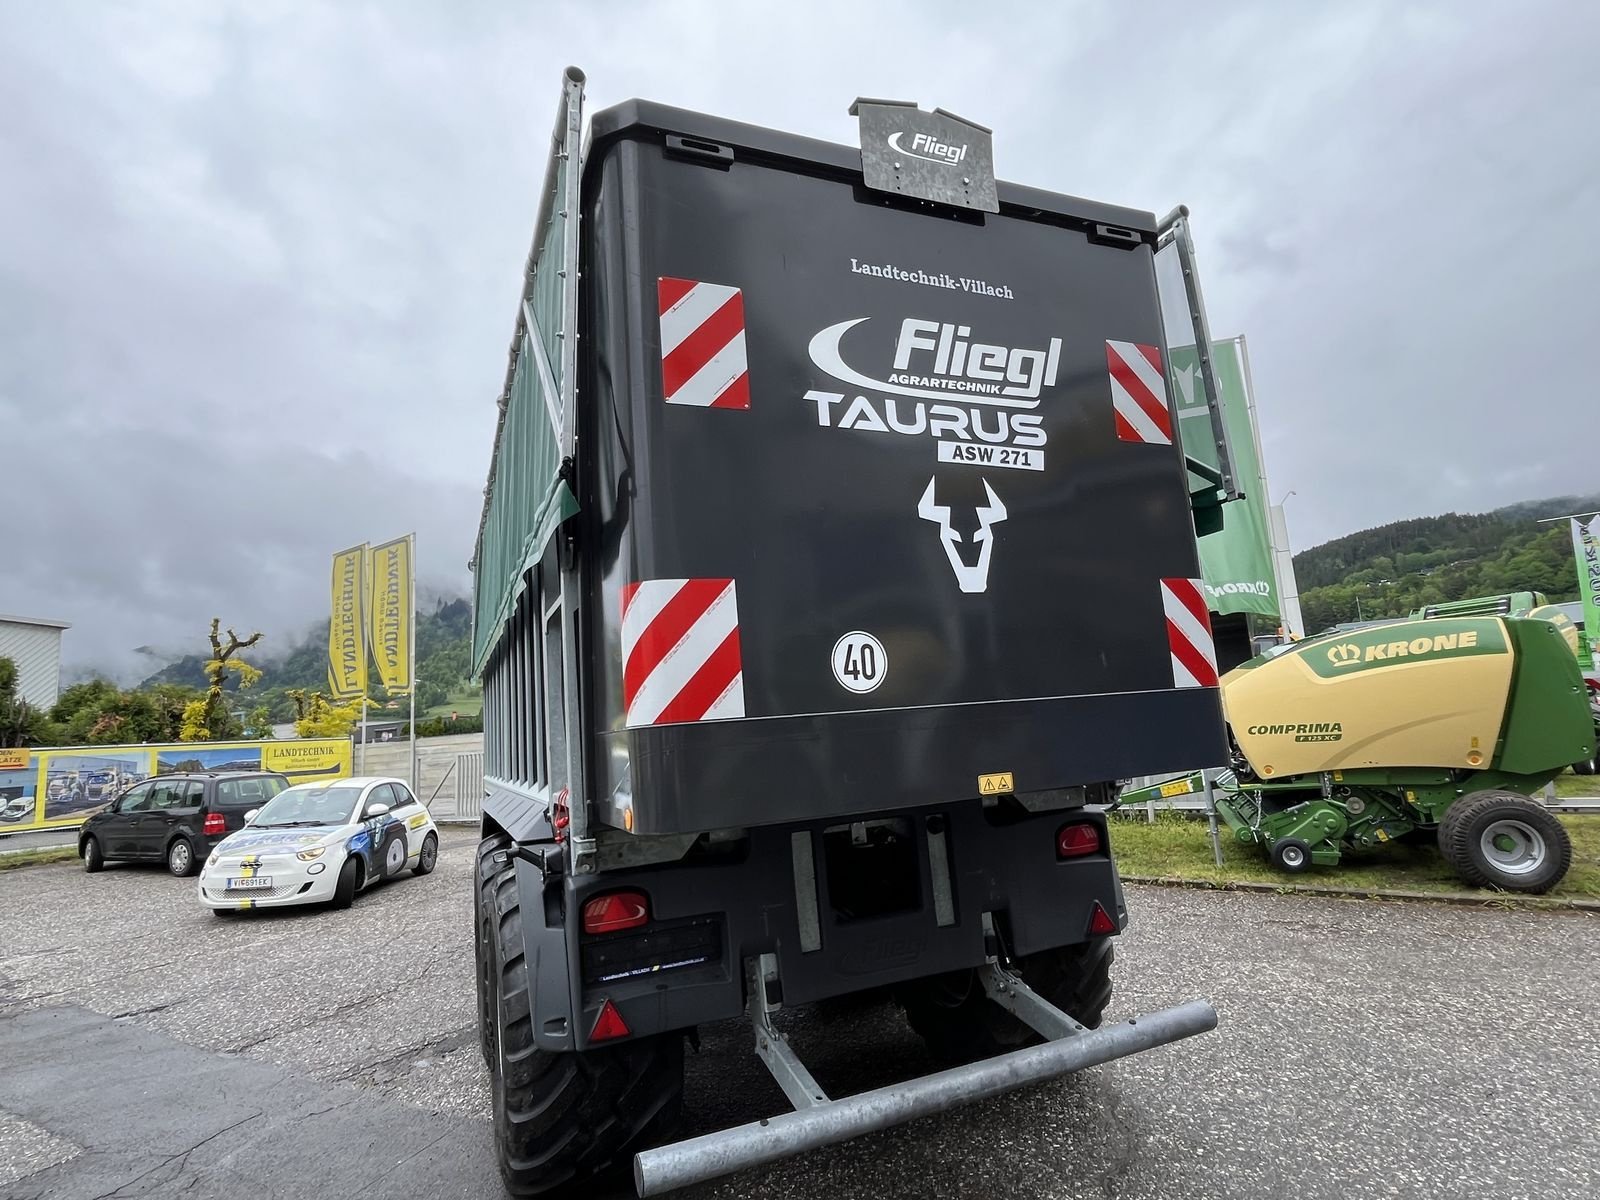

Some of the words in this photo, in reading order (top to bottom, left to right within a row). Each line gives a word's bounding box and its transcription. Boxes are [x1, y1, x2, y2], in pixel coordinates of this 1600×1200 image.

[911, 132, 968, 164] Fliegl
[850, 257, 1015, 300] Landtechnik-Villach
[893, 317, 1063, 398] Fliegl
[888, 372, 1001, 395] AGRARTECHNIK
[802, 389, 1048, 447] TAURUS
[952, 445, 994, 463] ASW
[999, 449, 1032, 467] 271
[843, 643, 876, 680] 40
[1364, 631, 1478, 662] KRONE
[1247, 722, 1343, 735] COMPRIMA
[273, 746, 334, 758] LANDTECHNIK
